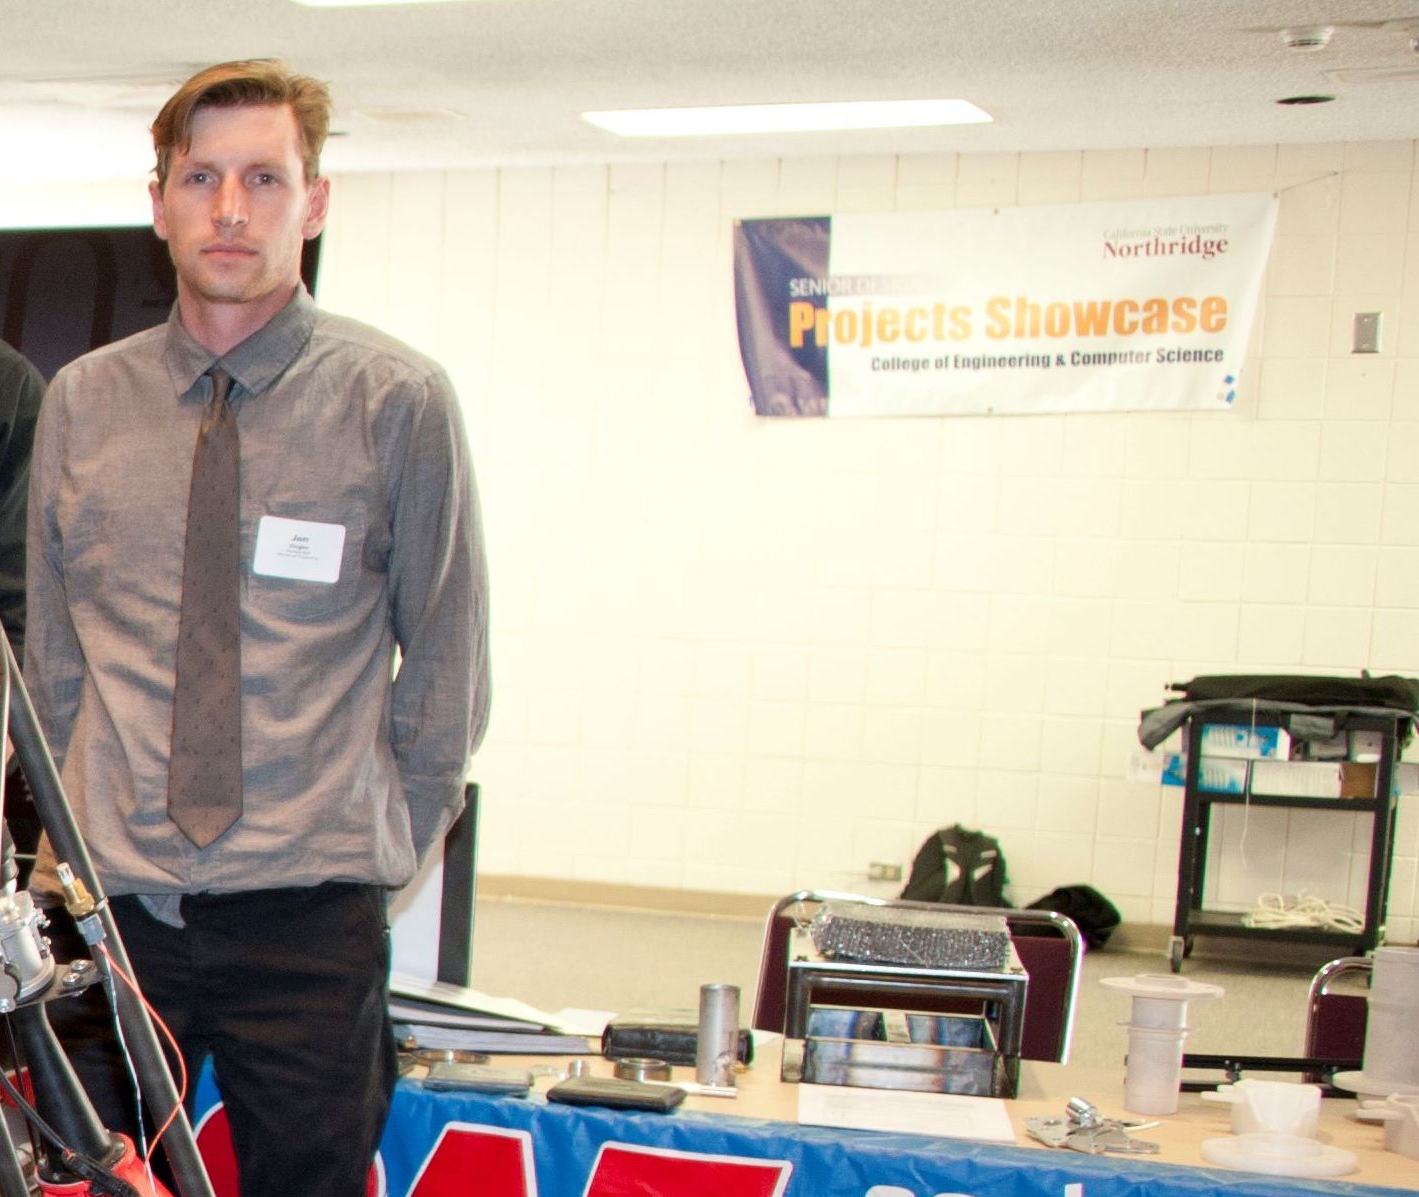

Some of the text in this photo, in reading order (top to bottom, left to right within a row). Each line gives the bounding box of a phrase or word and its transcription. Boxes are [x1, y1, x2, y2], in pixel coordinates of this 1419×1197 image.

[1103, 234, 1228, 259] Northridge
[790, 277, 851, 296] SENIOR
[789, 295, 1228, 348] Projects Showcase
[871, 347, 1224, 372] College of Engineering & Computer Science
